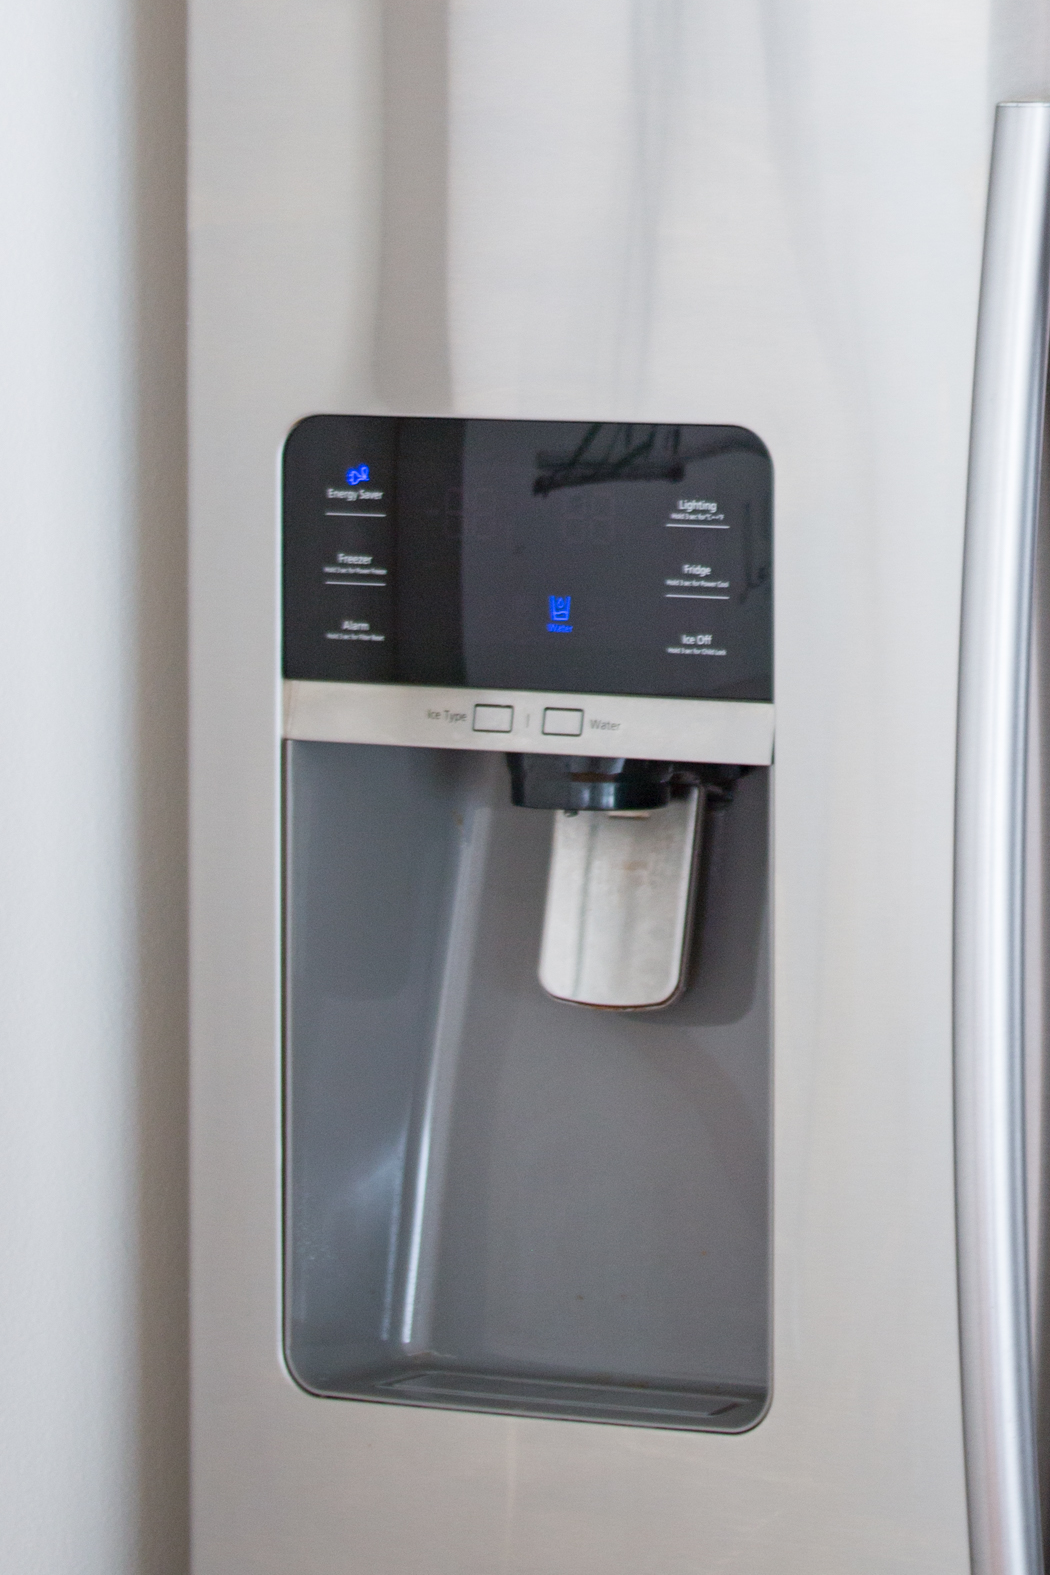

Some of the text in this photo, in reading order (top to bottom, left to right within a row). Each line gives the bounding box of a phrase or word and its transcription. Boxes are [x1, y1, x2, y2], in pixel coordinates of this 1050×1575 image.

[327, 488, 384, 501] Energy Saver
[678, 500, 718, 513] Lighting
[337, 553, 373, 565] Freezer
[682, 564, 712, 577] Fridge
[342, 620, 370, 631] Alarm
[547, 623, 573, 633] Water
[681, 634, 713, 645] Ice Off
[427, 709, 467, 723] Ice Type
[590, 719, 621, 732] Water
